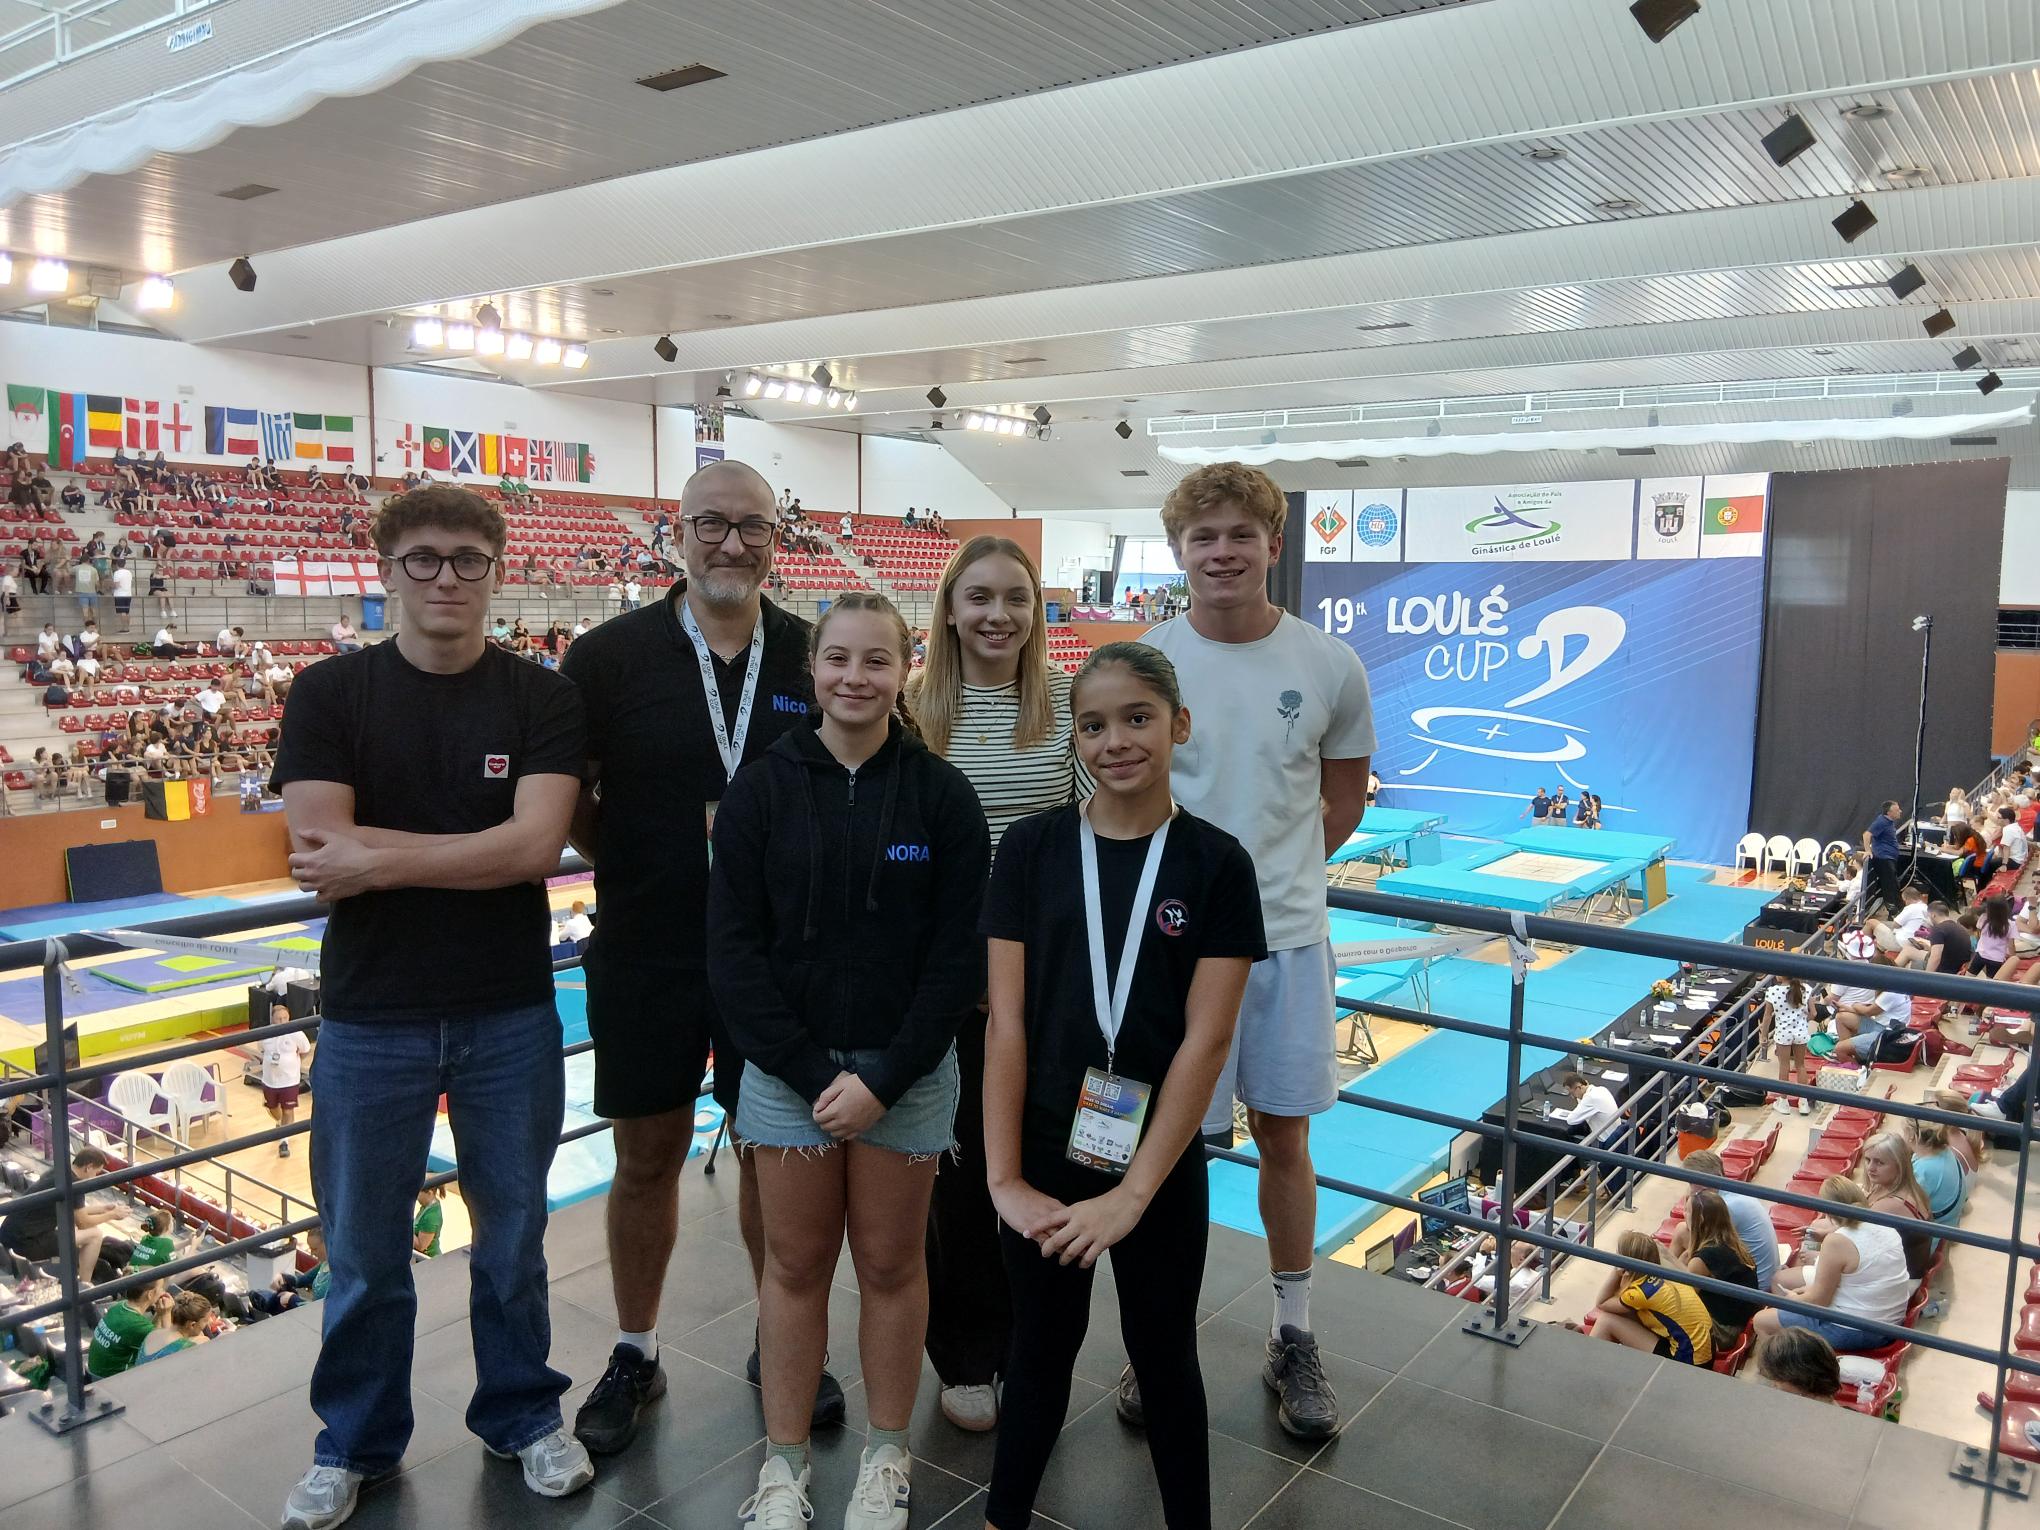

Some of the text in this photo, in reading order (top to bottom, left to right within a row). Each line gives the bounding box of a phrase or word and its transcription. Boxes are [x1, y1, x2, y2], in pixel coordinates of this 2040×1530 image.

[1320, 546, 1337, 555] FGP
[1471, 533, 1561, 555] Ginástica de Loulé
[1387, 584, 1509, 636] LOULÉ
[1424, 639, 1509, 682] CUP
[772, 694, 807, 714] Nico
[884, 844, 930, 861] NORA
